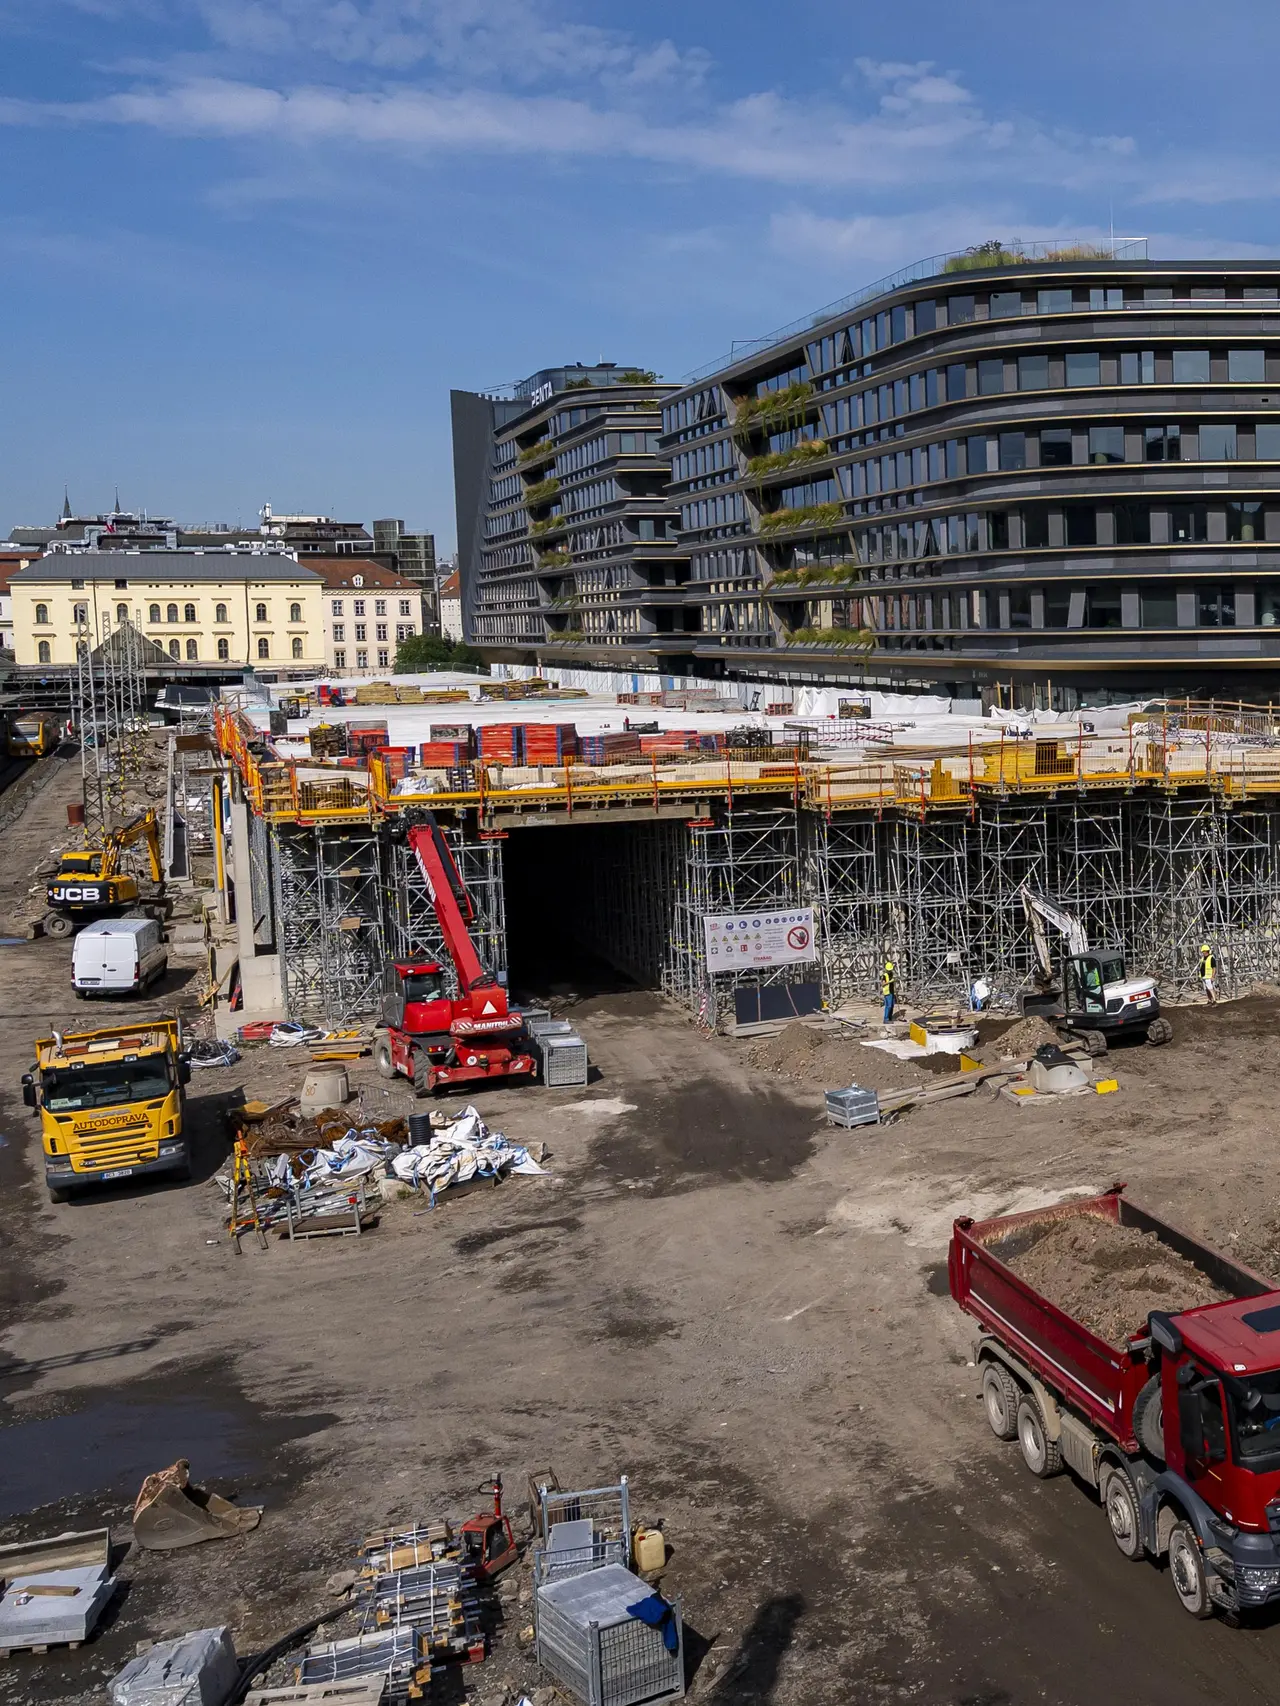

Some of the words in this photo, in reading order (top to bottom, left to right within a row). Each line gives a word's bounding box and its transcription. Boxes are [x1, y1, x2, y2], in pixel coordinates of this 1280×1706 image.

[531, 381, 553, 408] PENTA
[54, 888, 100, 901] JCB
[472, 1019, 509, 1031] MANITOU
[305, 1085, 316, 1097] 80
[73, 1112, 149, 1131] AUTODOPRAVA
